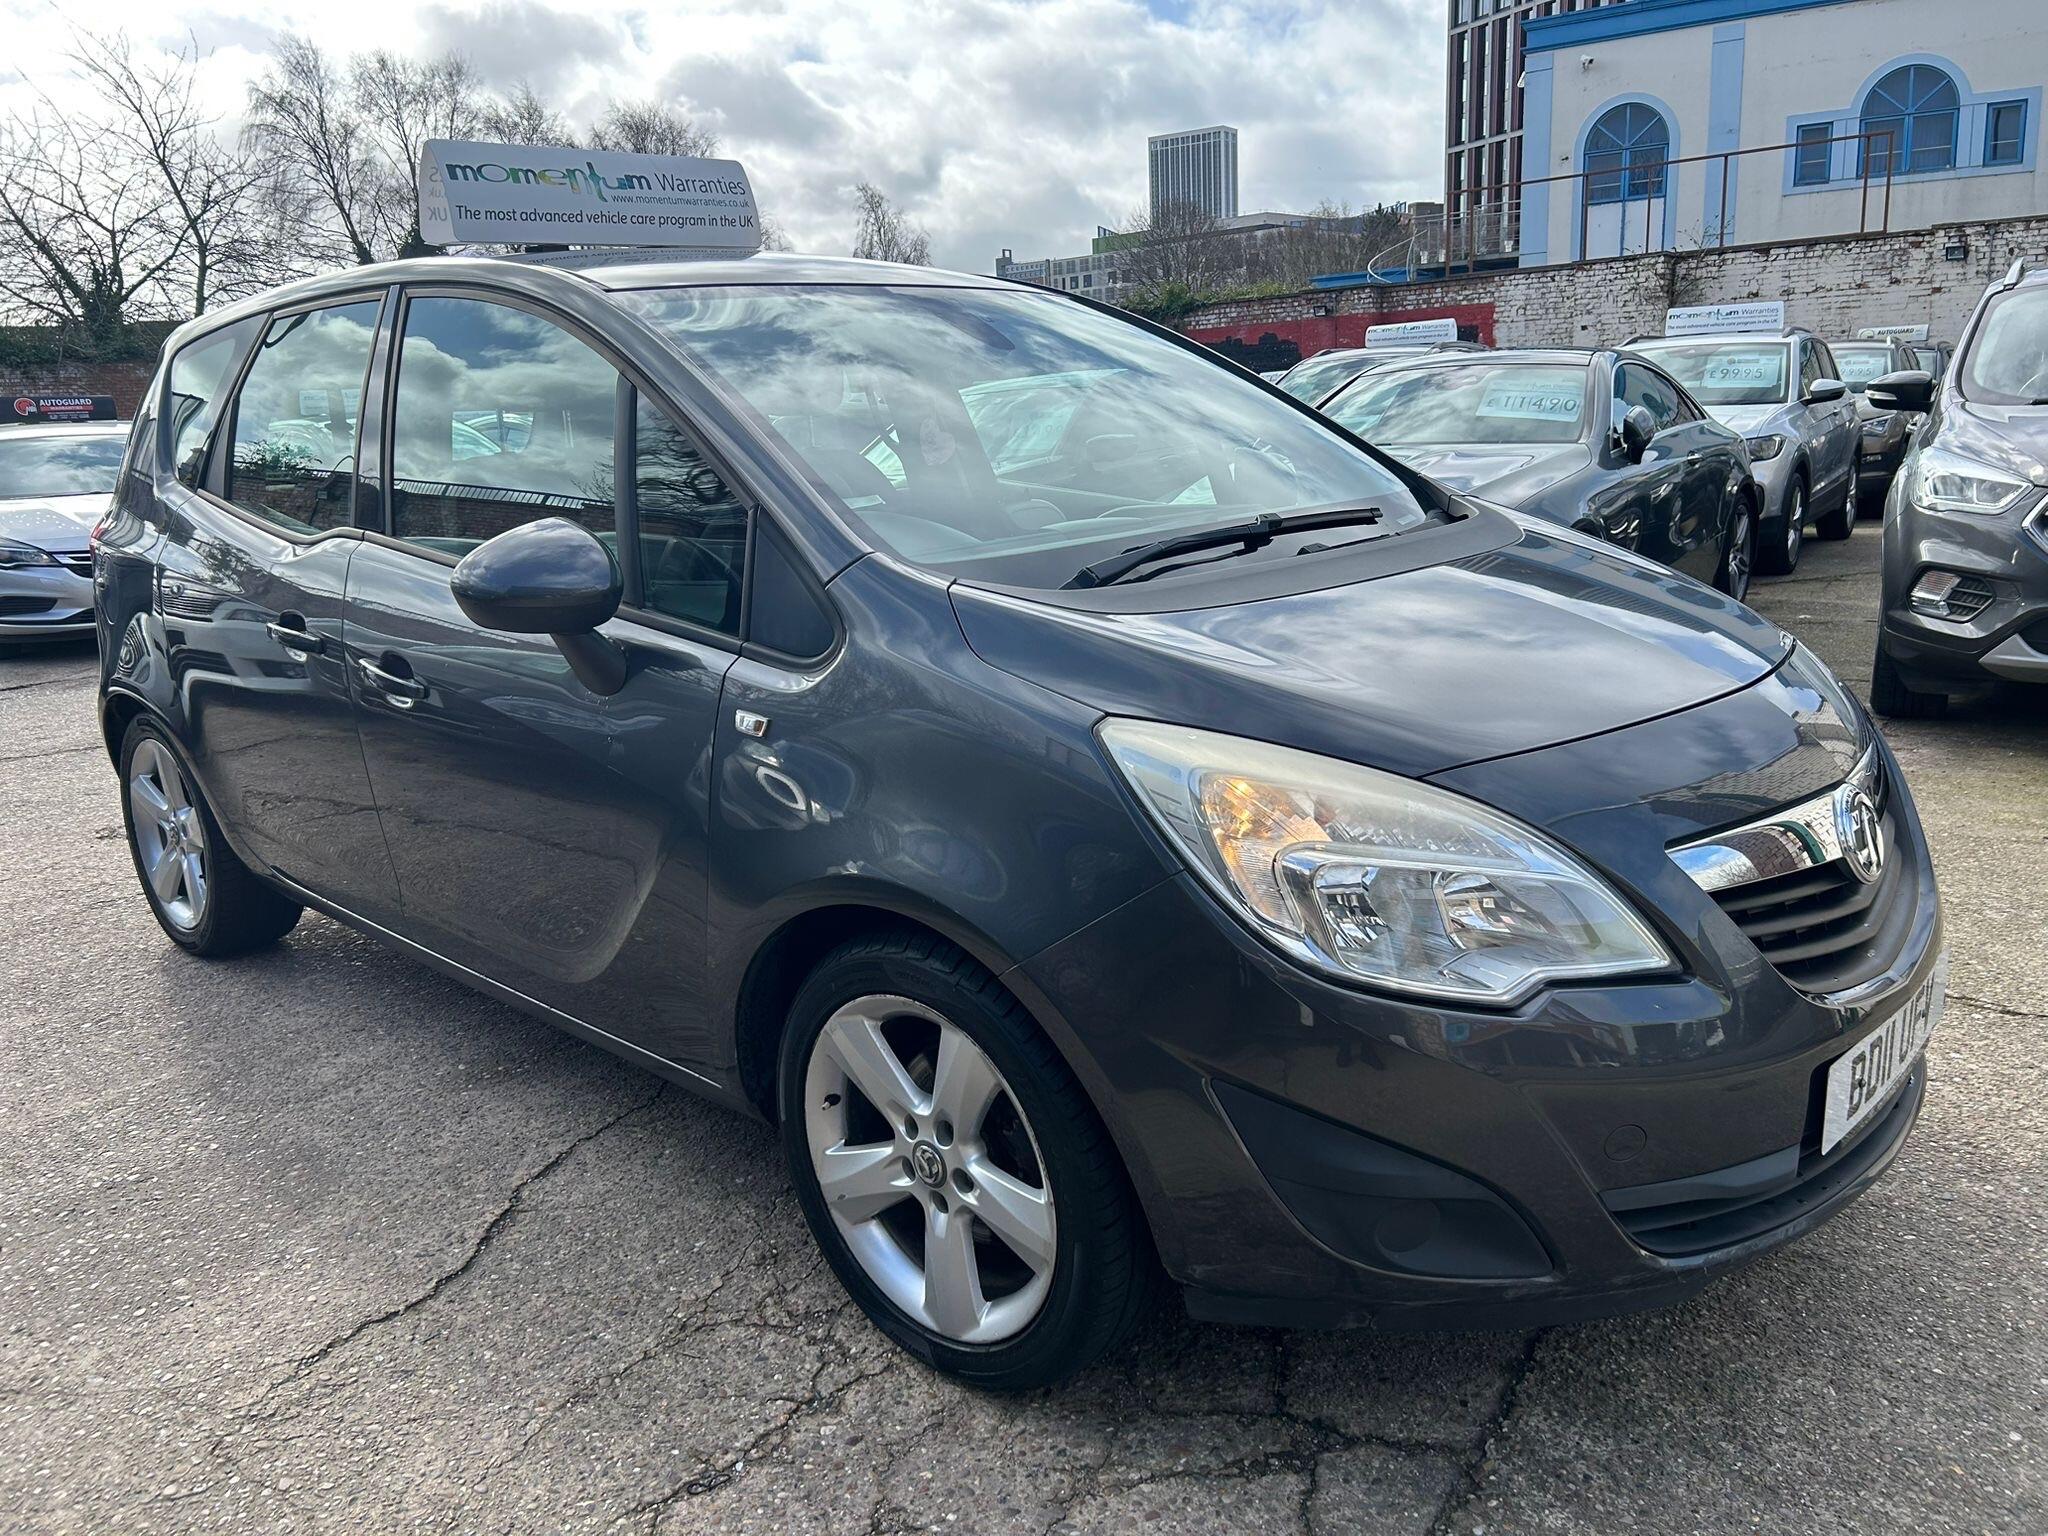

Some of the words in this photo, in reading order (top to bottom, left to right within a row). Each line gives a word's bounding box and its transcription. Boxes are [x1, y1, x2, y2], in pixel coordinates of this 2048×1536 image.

[446, 162, 652, 202] momentum
[655, 172, 746, 195] Warranties
[611, 194, 750, 208] www.momentumwarranties.co.uk
[456, 205, 481, 220] The
[485, 207, 517, 221] most
[520, 208, 583, 223] advanced
[586, 210, 627, 225] vehicle
[630, 213, 655, 225] care
[659, 214, 706, 229] program
[708, 214, 718, 226] in
[720, 214, 737, 227] the
[739, 214, 754, 227] UK
[1741, 306, 1779, 315] Warranties
[39, 398, 92, 406] AUTOGUARD
[1847, 1018, 1897, 1121] BD11
